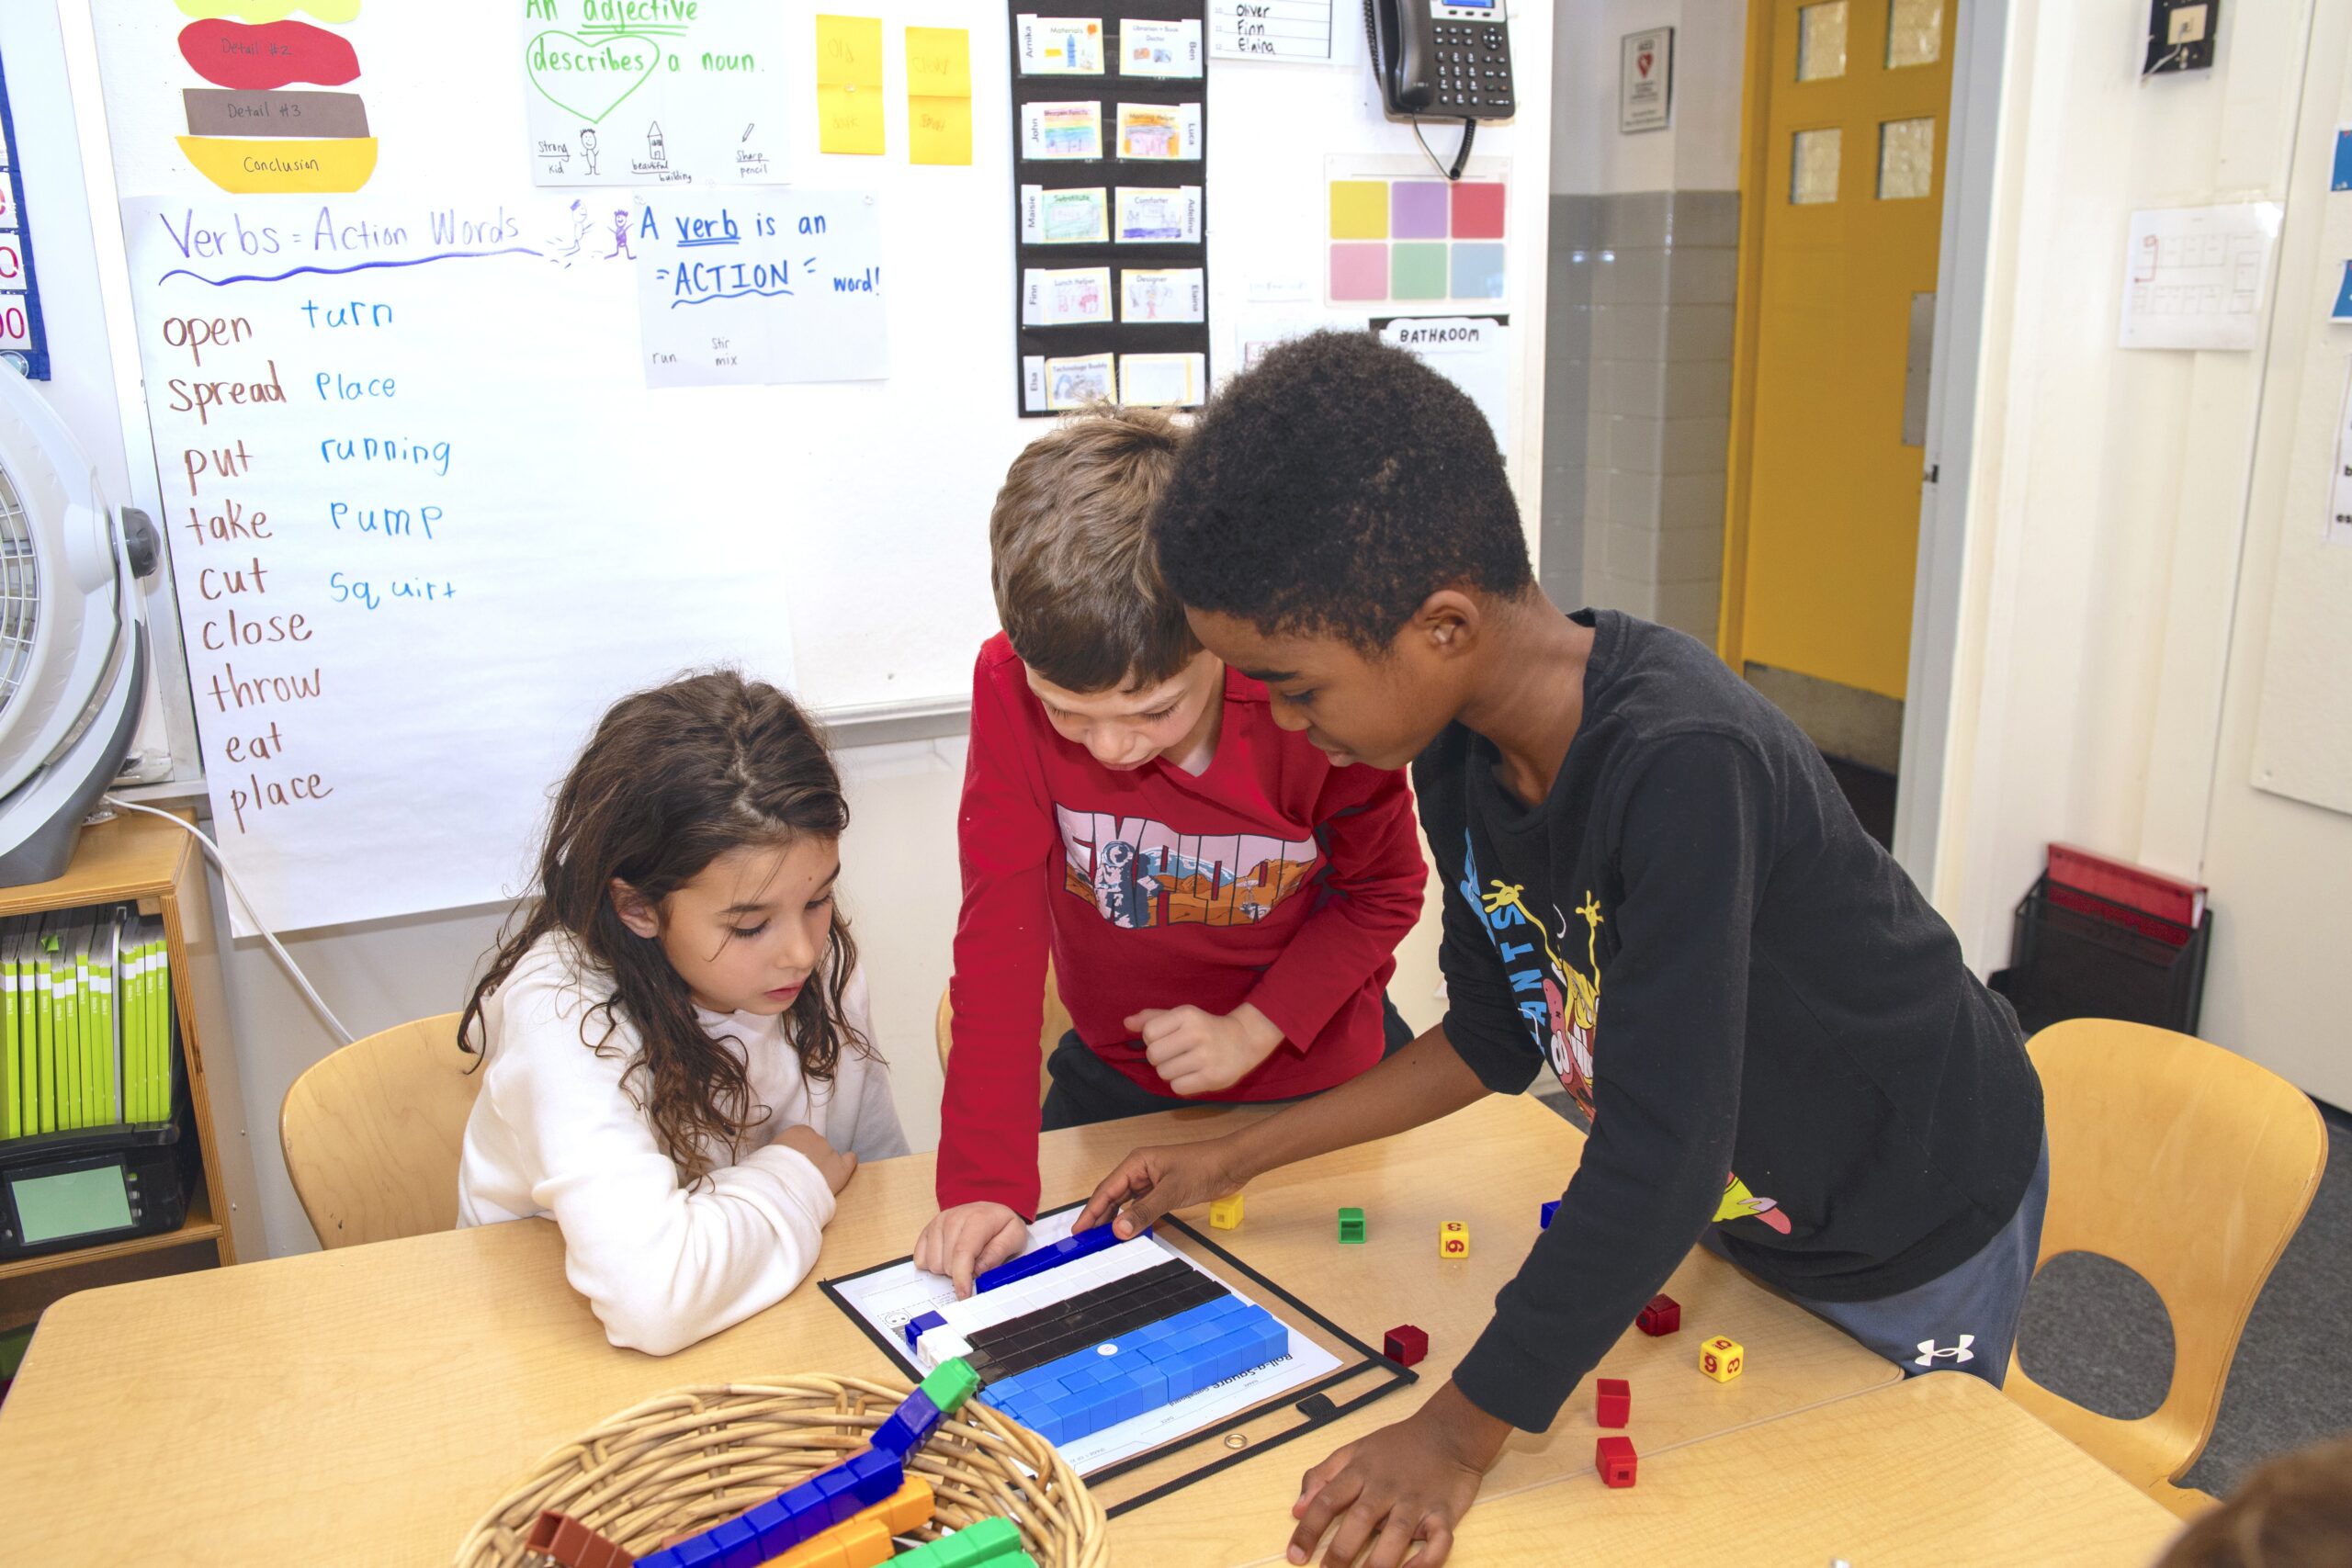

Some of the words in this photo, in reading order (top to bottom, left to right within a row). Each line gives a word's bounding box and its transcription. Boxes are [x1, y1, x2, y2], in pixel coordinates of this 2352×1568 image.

[582, 0, 698, 34] adjective
[1236, 3, 1271, 18] Oliver
[1238, 18, 1265, 36] Finn
[220, 37, 258, 56] Detail
[268, 43, 293, 56] #2
[533, 37, 645, 73] describes
[668, 55, 680, 73] a
[702, 51, 764, 73] noun.
[1189, 41, 1197, 61] Ben
[1238, 38, 1276, 55] Elaina
[228, 103, 269, 118] Detail
[279, 104, 301, 118] #3
[243, 157, 319, 173] Conclusion
[631, 159, 669, 172] beautiful
[659, 171, 692, 184] building
[741, 164, 768, 176] pencil
[160, 209, 280, 258] Verbs
[314, 206, 408, 252] Action
[430, 206, 519, 247] Words
[640, 206, 659, 240] A
[676, 209, 741, 239] verb
[756, 210, 775, 236] is
[797, 213, 826, 235] an
[674, 259, 789, 296] ACTION
[833, 266, 881, 297] word!
[1029, 285, 1037, 305] Finn
[300, 299, 393, 328] turn
[163, 317, 253, 367] open
[1399, 327, 1480, 344] BATHROOM
[652, 352, 677, 366] run
[715, 352, 738, 367] mix
[184, 439, 254, 496] put
[322, 437, 450, 476] running
[185, 499, 273, 546] take
[199, 557, 267, 600] cut
[202, 609, 312, 650] close
[208, 662, 321, 712] throw
[225, 722, 282, 762] eat
[231, 773, 334, 834] place
